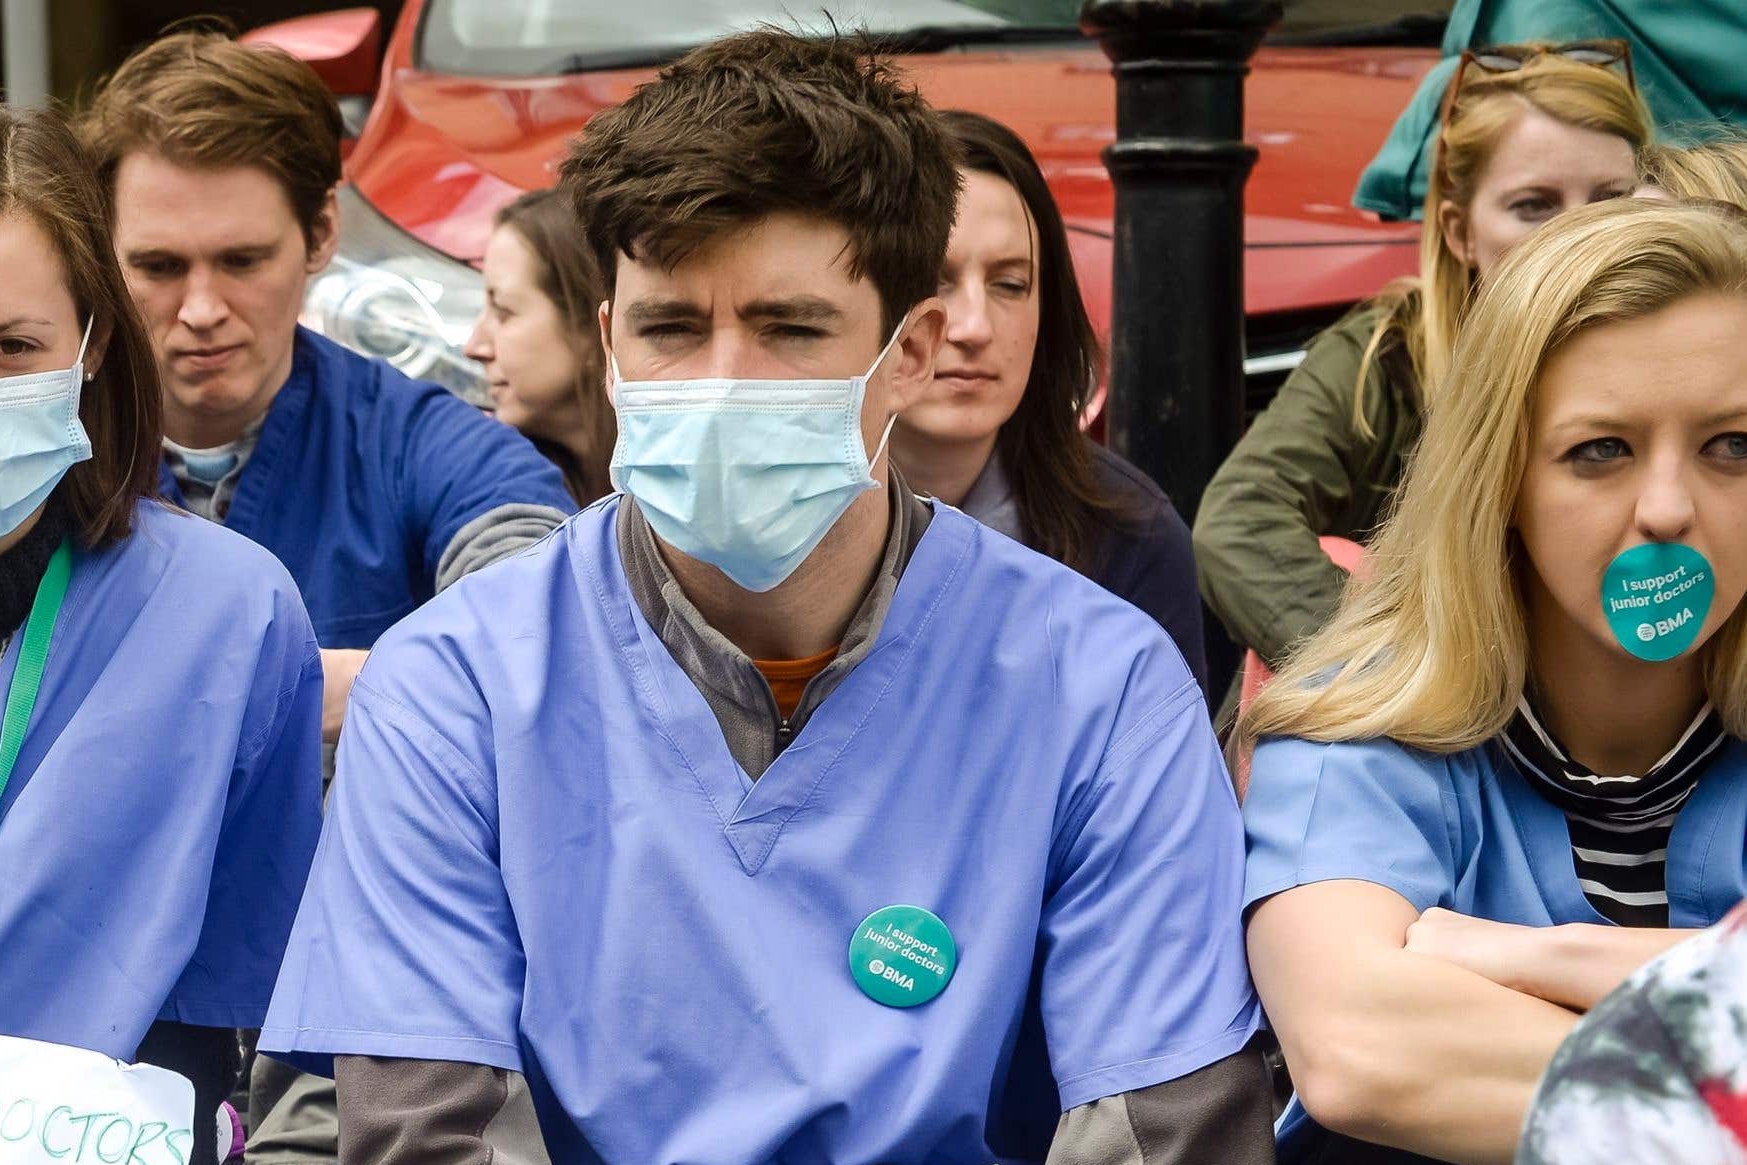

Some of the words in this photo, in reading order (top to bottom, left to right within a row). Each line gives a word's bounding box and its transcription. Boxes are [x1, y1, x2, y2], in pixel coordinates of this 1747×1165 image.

[1610, 595, 1651, 613] junior
[1653, 572, 1705, 604] doctors
[1622, 579, 1629, 592] I
[1630, 565, 1687, 592] support
[1655, 607, 1694, 637] BMA
[864, 928, 901, 952] junior
[901, 948, 945, 976] doctors
[886, 923, 893, 933] I
[892, 928, 939, 957] support
[882, 966, 915, 992] BMA
